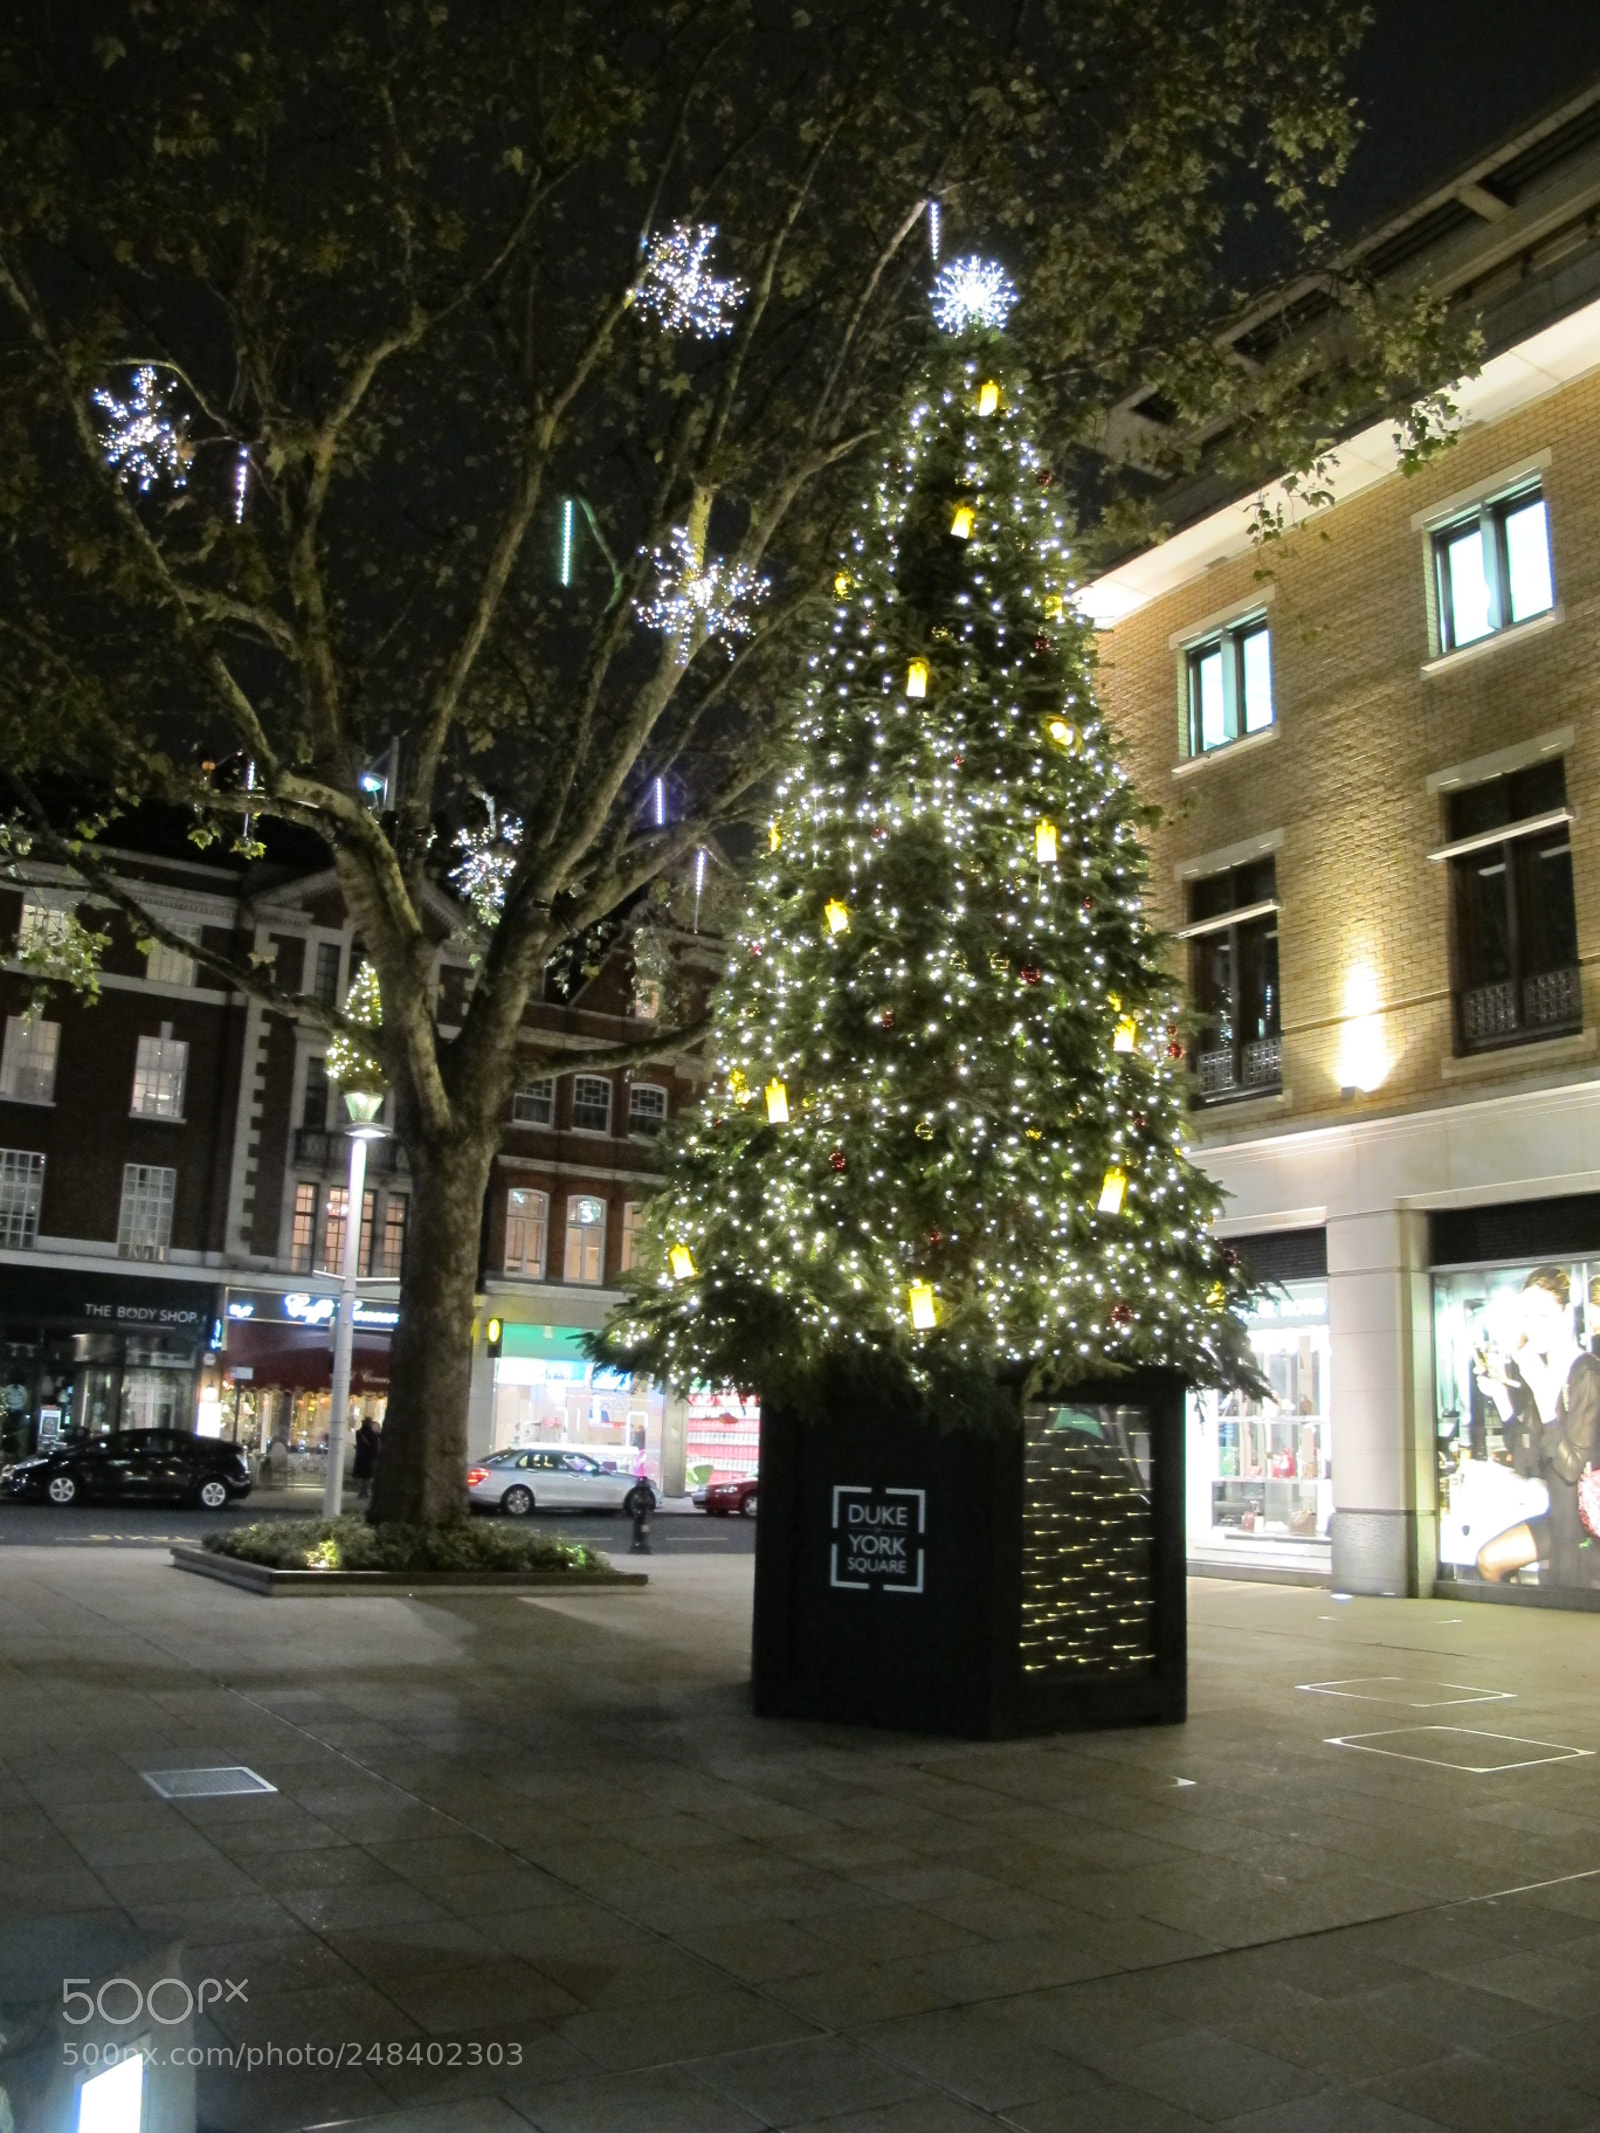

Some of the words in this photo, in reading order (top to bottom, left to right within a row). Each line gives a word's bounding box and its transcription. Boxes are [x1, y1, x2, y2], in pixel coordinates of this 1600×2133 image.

[85, 1303, 112, 1316] THE
[117, 1305, 157, 1319] BODY
[160, 1309, 196, 1323] SHOP
[848, 1504, 908, 1526] DUKE
[848, 1534, 906, 1556] YORK
[848, 1557, 907, 1574] SQUARE
